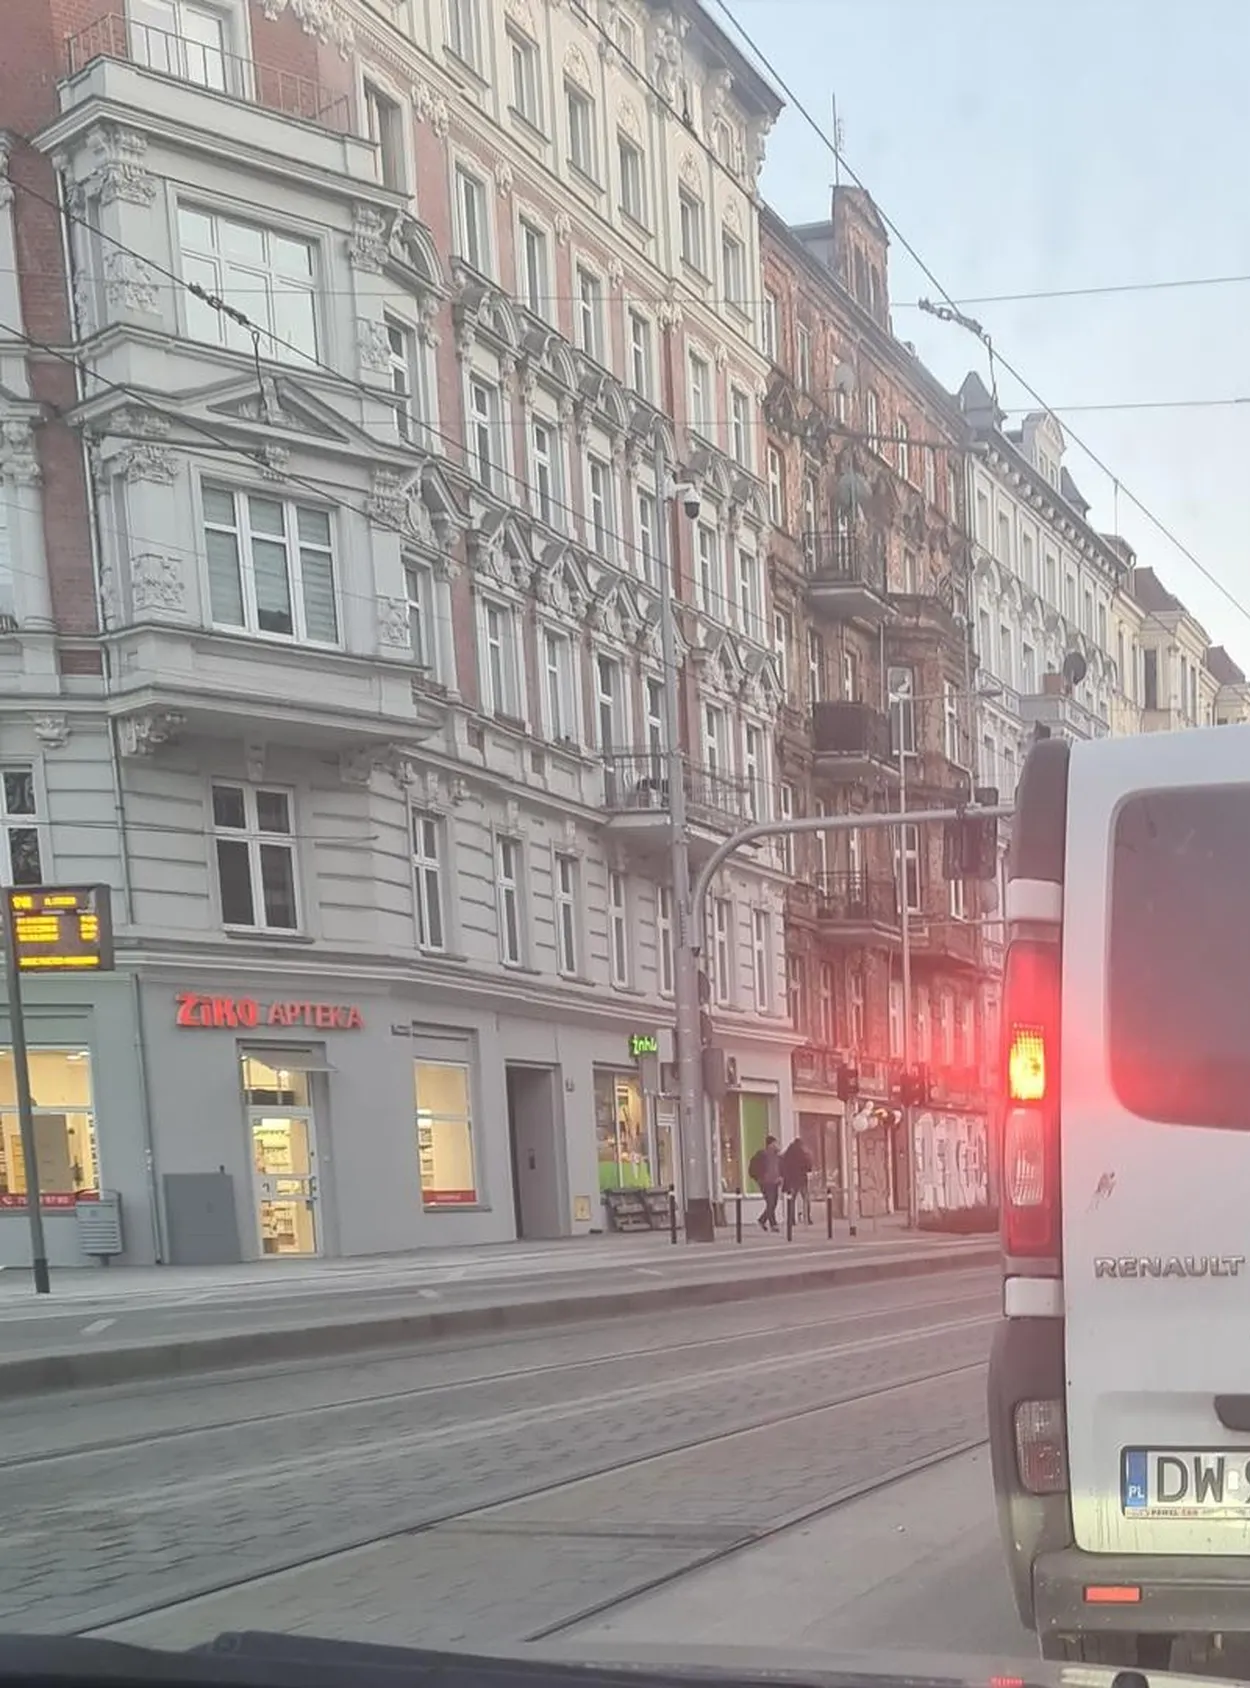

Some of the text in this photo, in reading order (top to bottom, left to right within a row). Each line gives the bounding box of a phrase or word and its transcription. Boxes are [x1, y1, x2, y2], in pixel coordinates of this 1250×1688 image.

[267, 1001, 365, 1029] APTEKA
[1094, 1256, 1245, 1278] RENAULT
[1128, 1485, 1145, 1499] PL
[1157, 1456, 1224, 1503] DW
